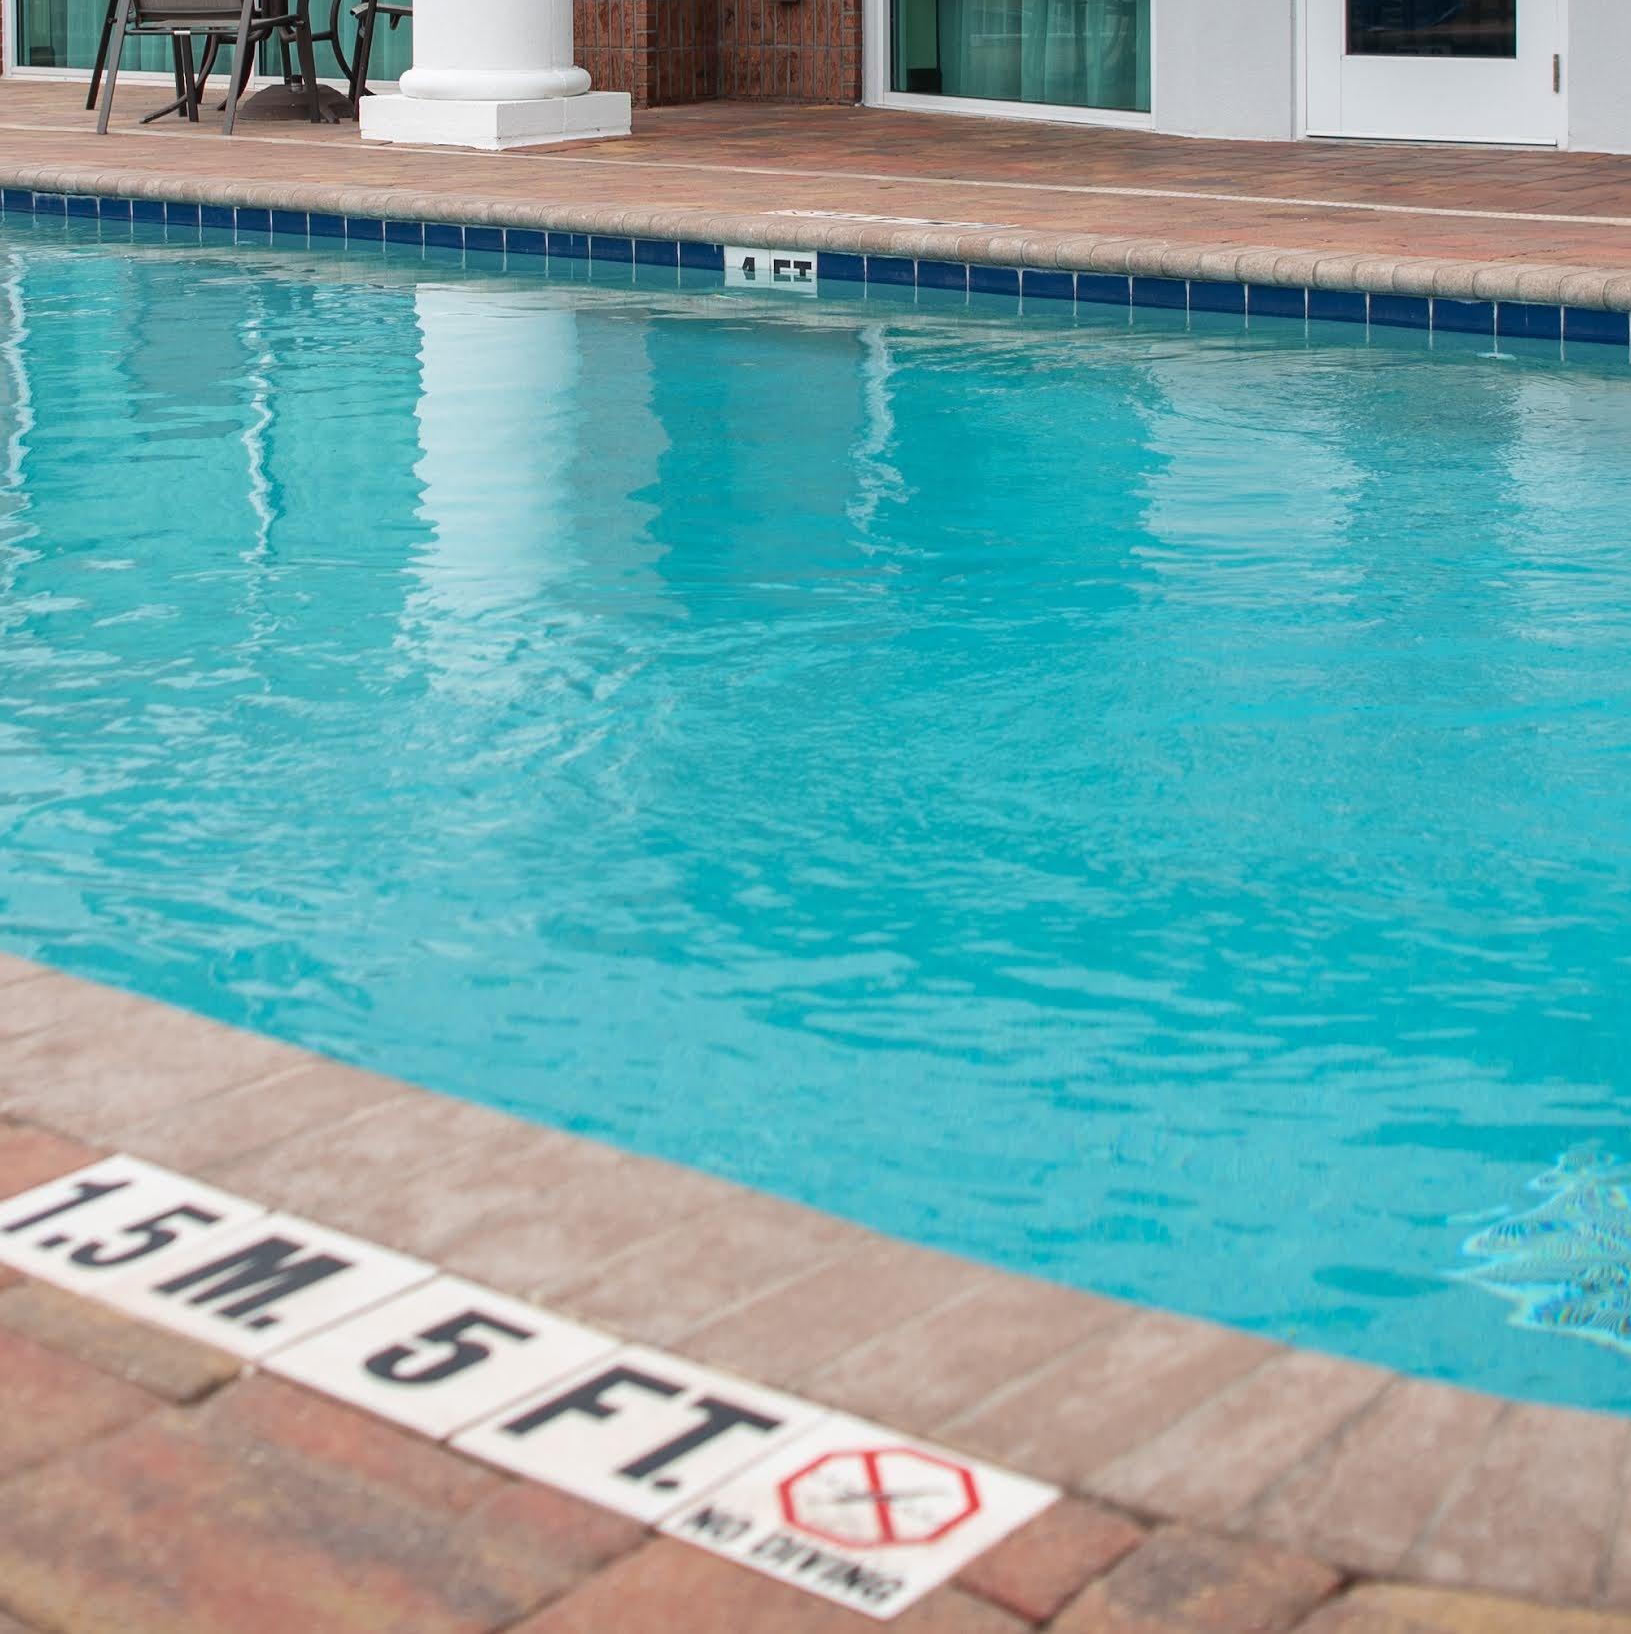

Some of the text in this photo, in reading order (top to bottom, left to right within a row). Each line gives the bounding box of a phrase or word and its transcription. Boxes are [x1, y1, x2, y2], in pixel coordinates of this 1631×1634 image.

[154, 1237, 352, 1332] M.
[363, 1307, 539, 1388] 5
[501, 1363, 783, 1493] FT.
[684, 1503, 907, 1604] NO DIVING
